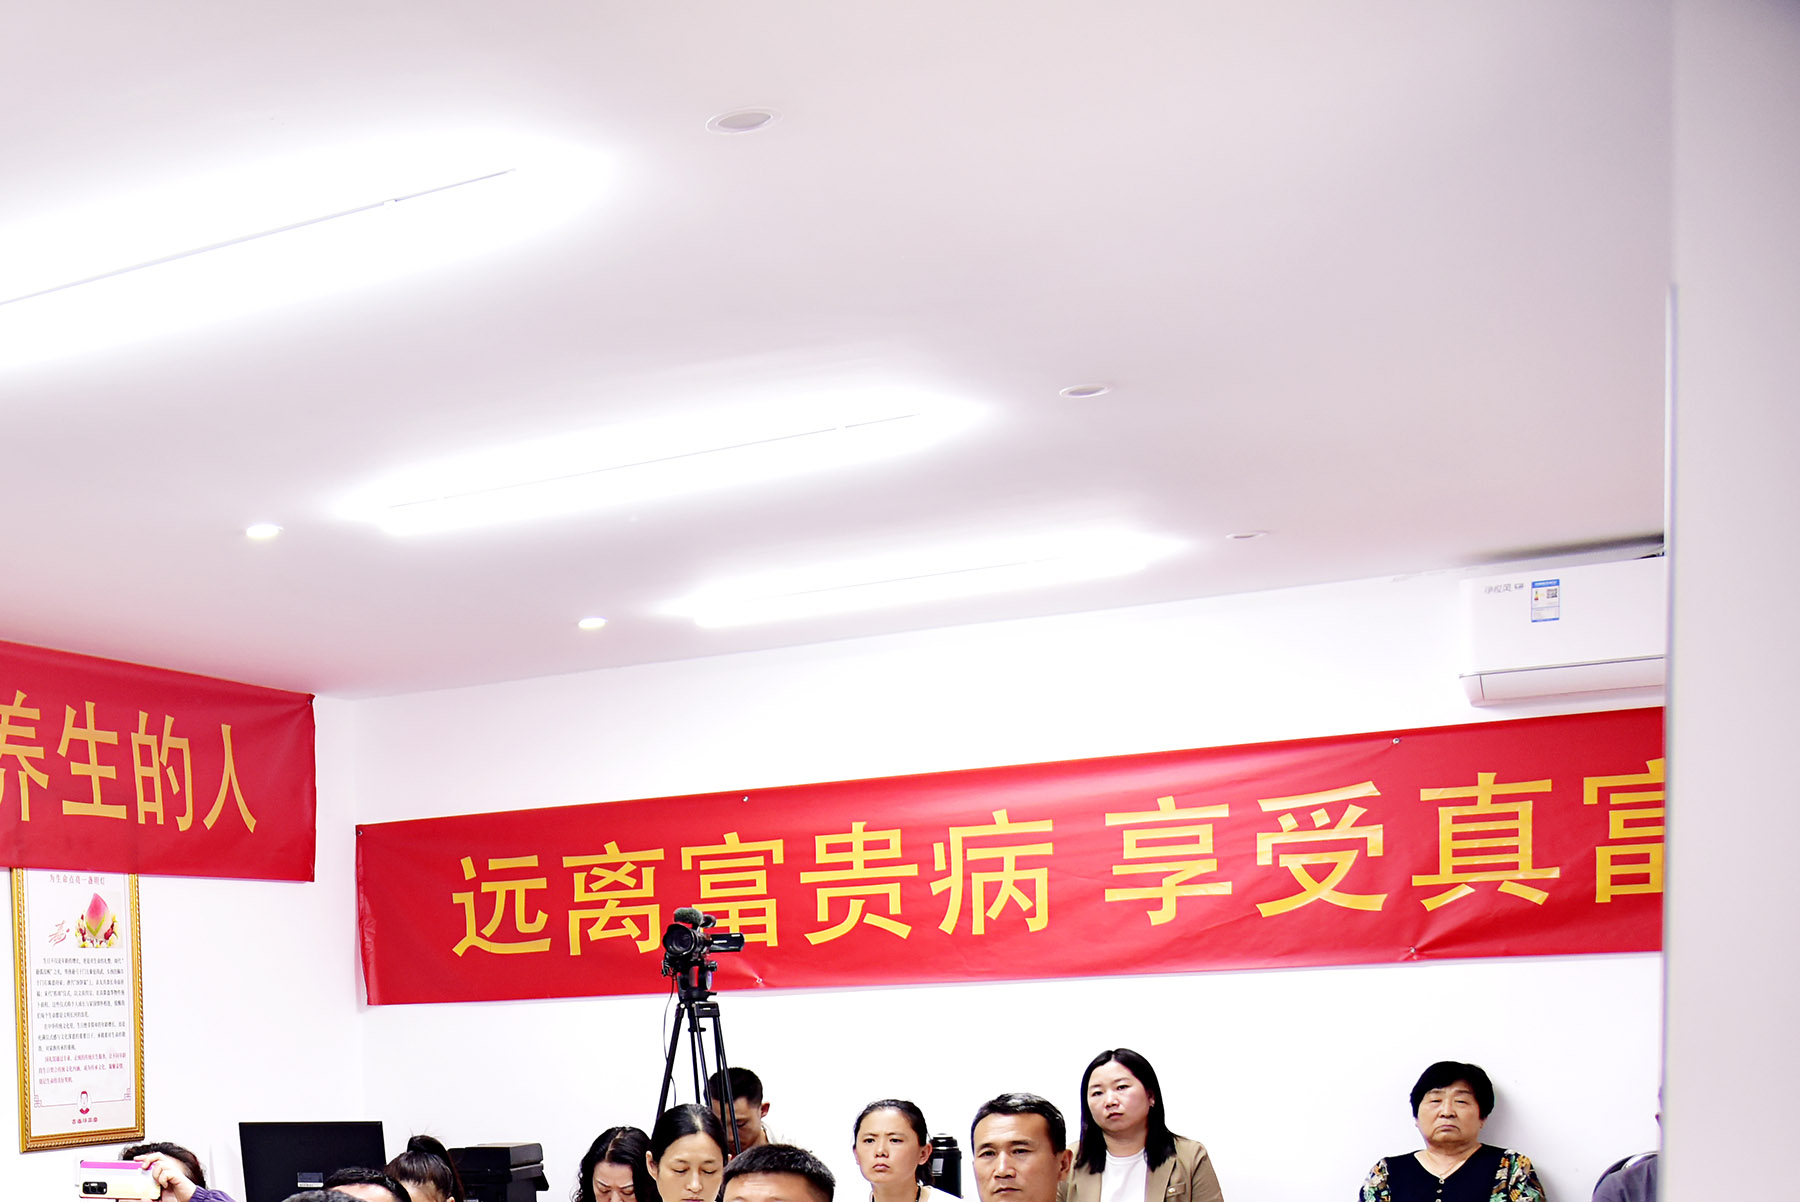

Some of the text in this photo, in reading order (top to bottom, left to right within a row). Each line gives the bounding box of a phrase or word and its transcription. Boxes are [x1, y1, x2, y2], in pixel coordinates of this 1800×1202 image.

[452, 758, 1666, 957] 远离富贵病 享受真富
